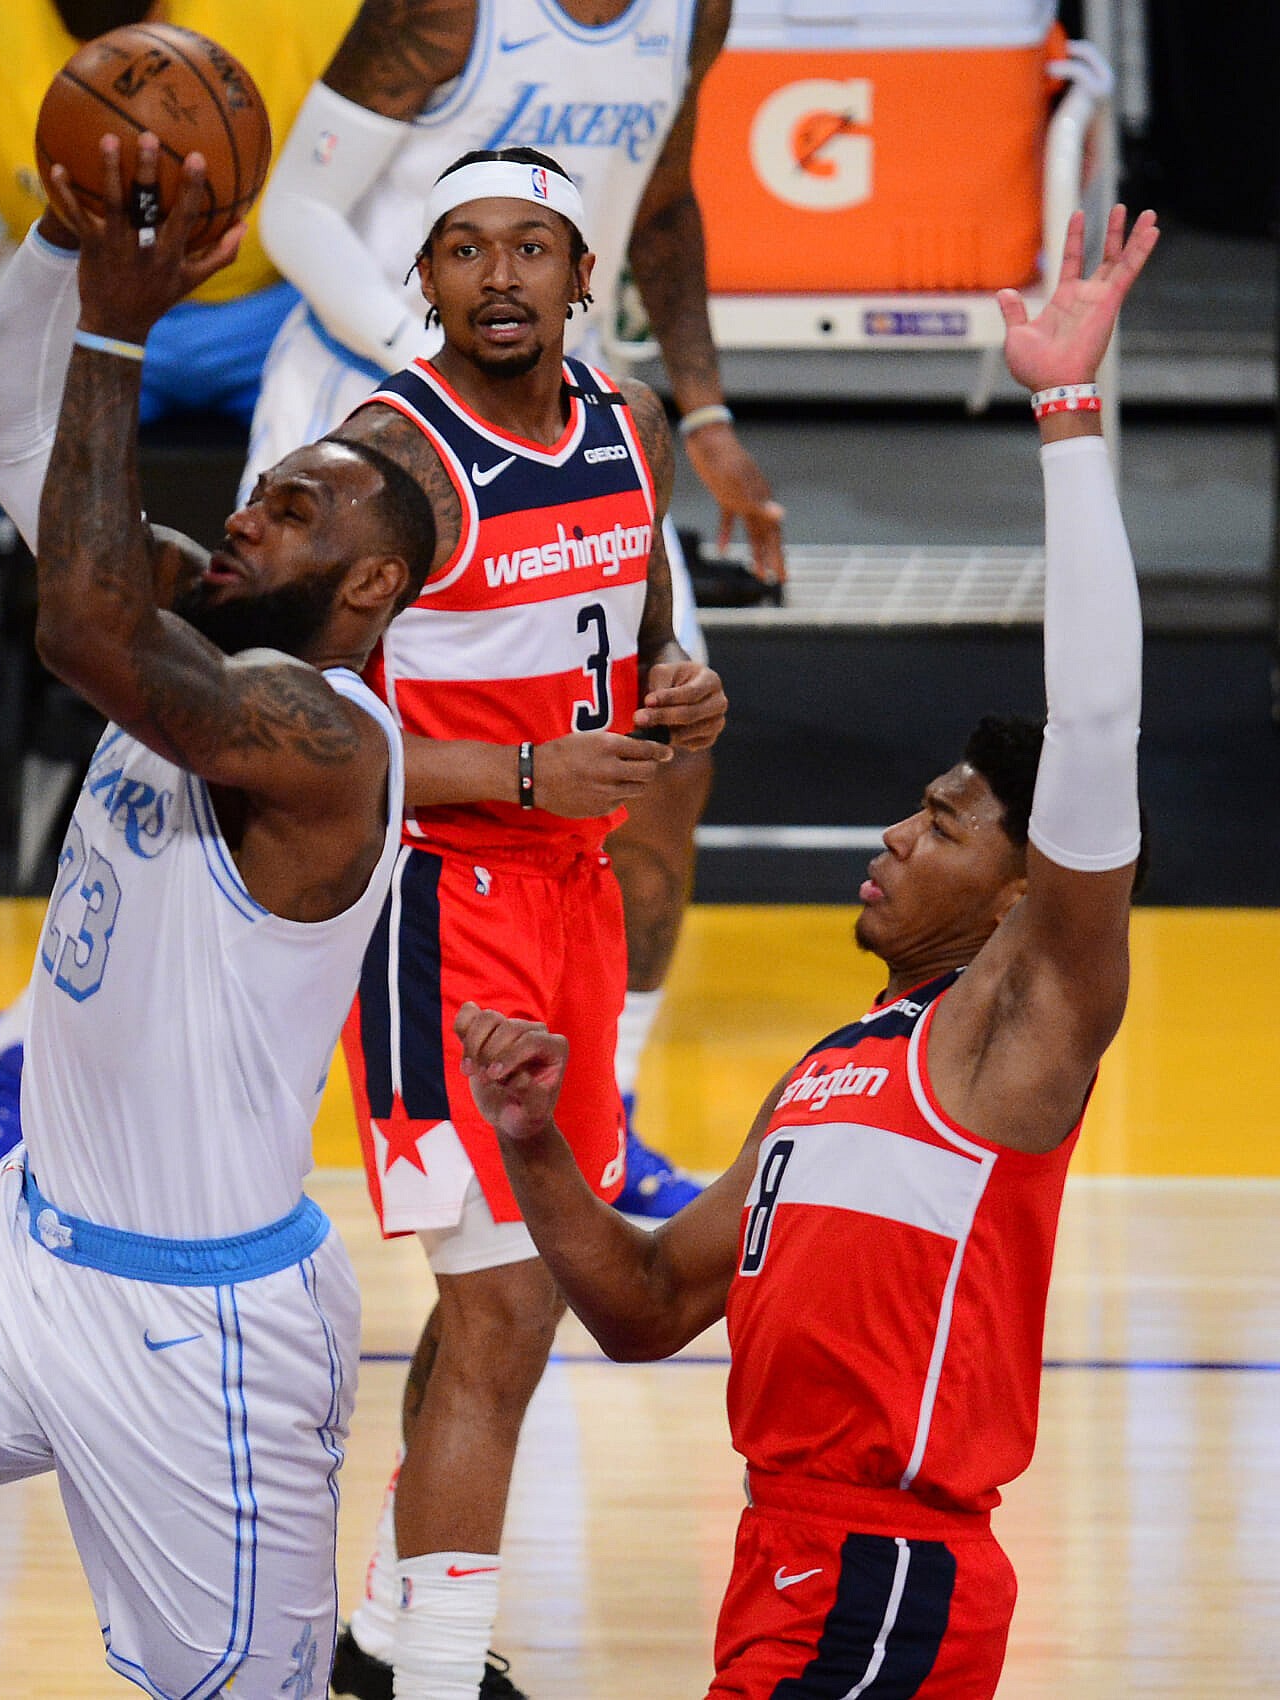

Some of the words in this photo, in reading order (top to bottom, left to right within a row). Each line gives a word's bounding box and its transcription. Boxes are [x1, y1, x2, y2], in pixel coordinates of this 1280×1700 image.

[749, 77, 875, 212] G
[584, 445, 628, 464] GEICO
[484, 523, 651, 588] washington
[572, 601, 613, 732] 3
[42, 812, 121, 1003] 23
[739, 1139, 795, 1277] 8
